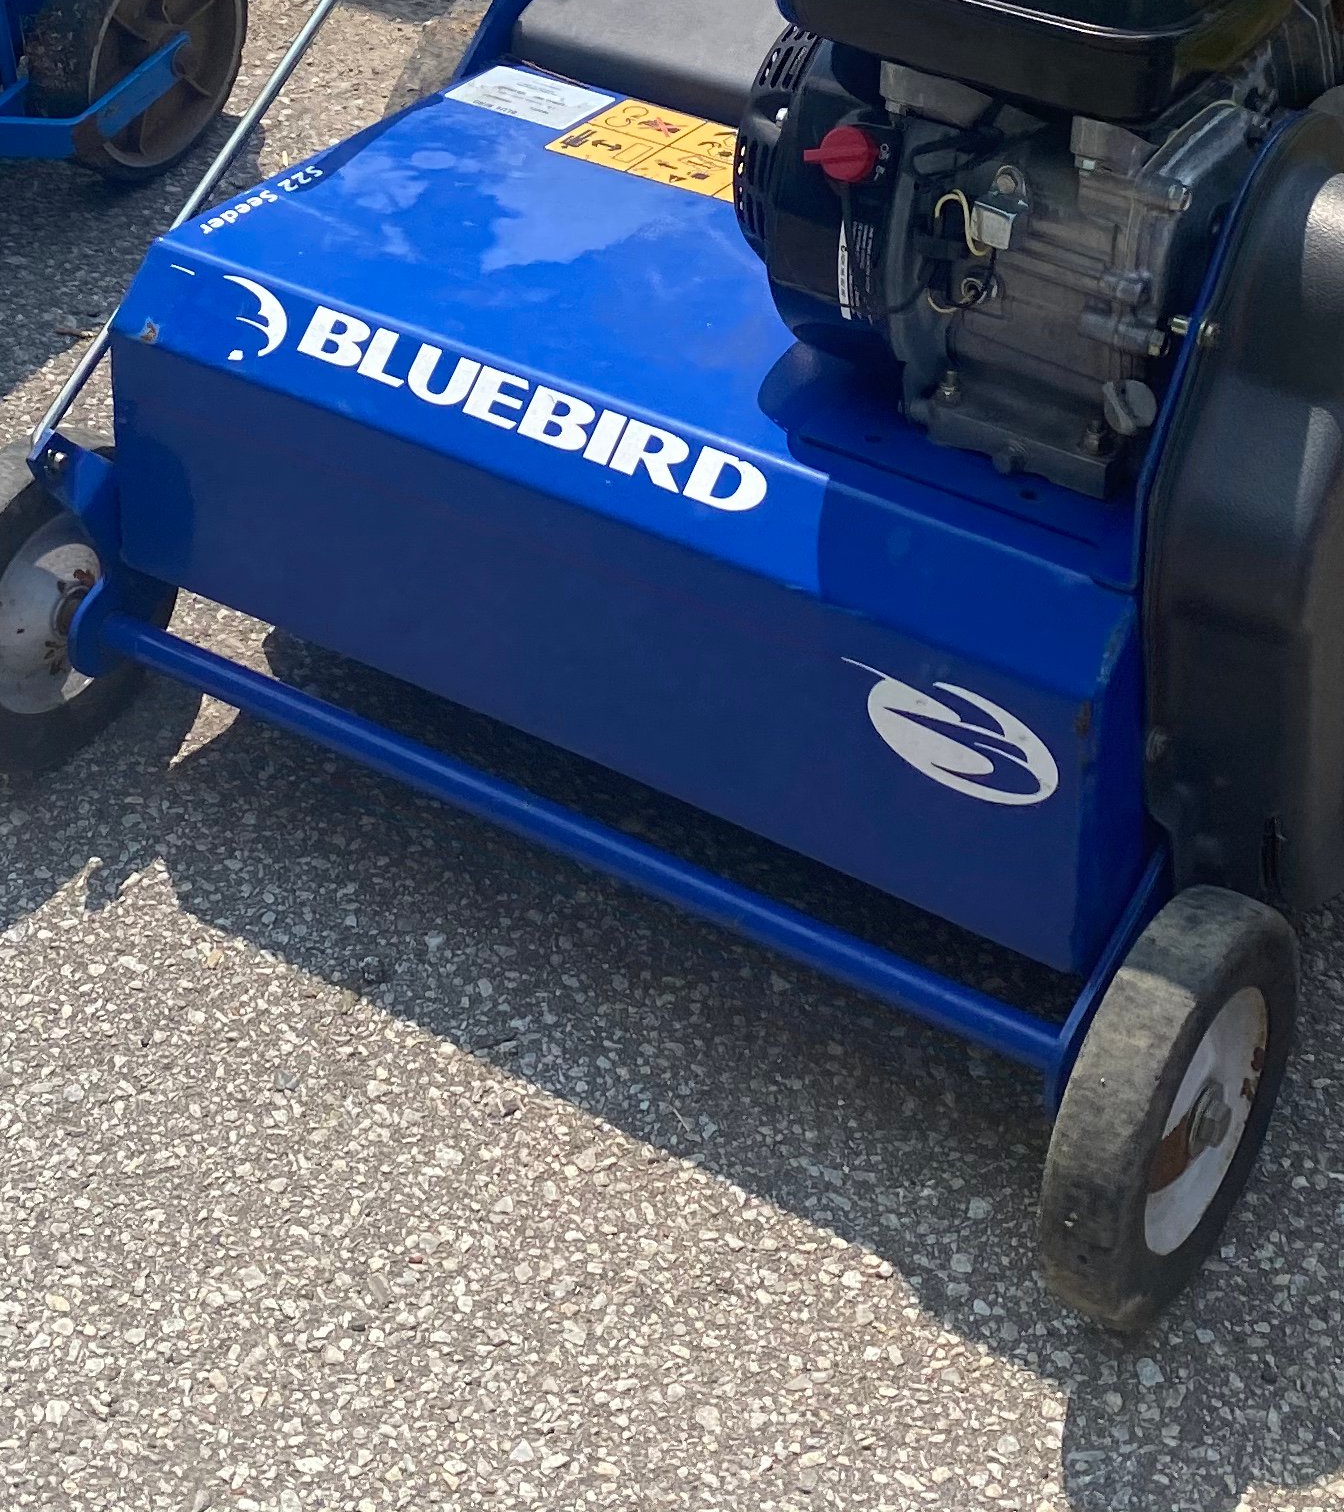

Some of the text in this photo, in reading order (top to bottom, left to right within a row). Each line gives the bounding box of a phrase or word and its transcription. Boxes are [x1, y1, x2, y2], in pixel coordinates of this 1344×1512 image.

[199, 164, 323, 236] S22 Seeder
[296, 304, 768, 513] BLUEBIRD
